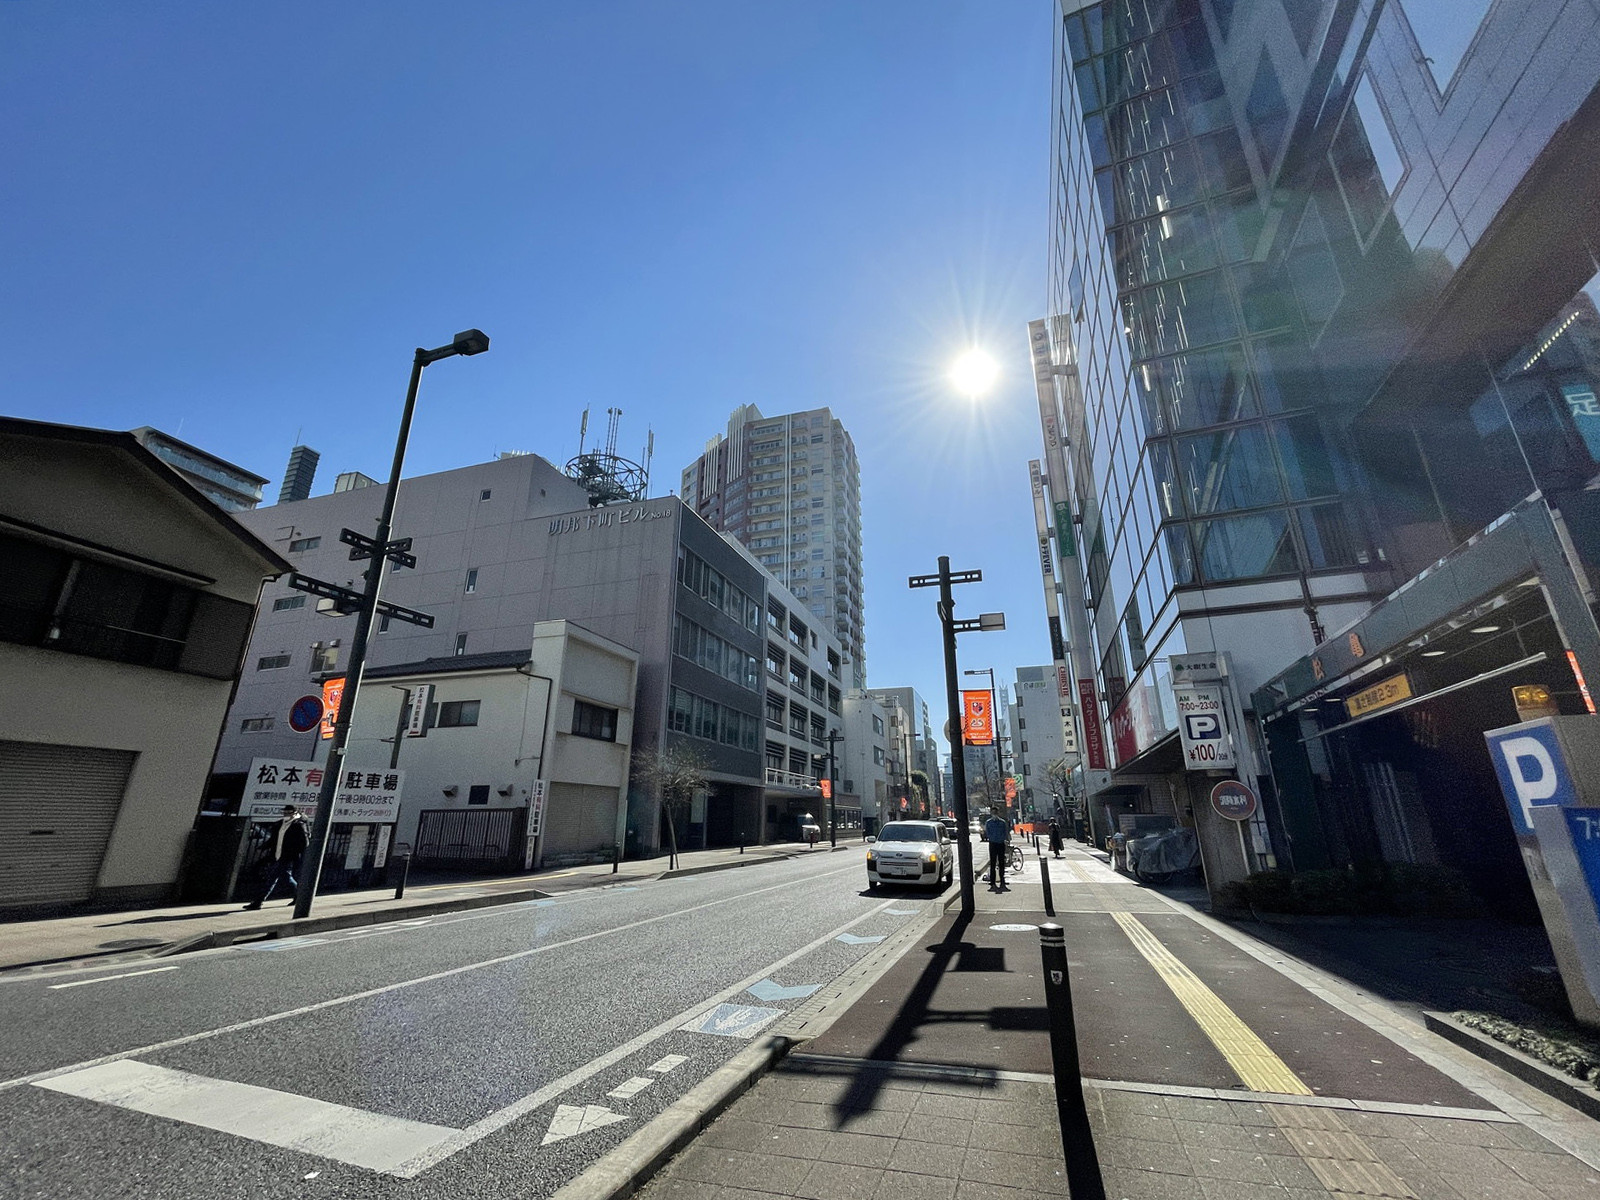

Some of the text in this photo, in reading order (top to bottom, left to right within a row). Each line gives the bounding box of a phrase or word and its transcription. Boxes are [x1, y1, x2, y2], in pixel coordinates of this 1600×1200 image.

[1189, 717, 1216, 738] P
[257, 764, 399, 791] 松本有駐車場
[1500, 737, 1557, 828] P
